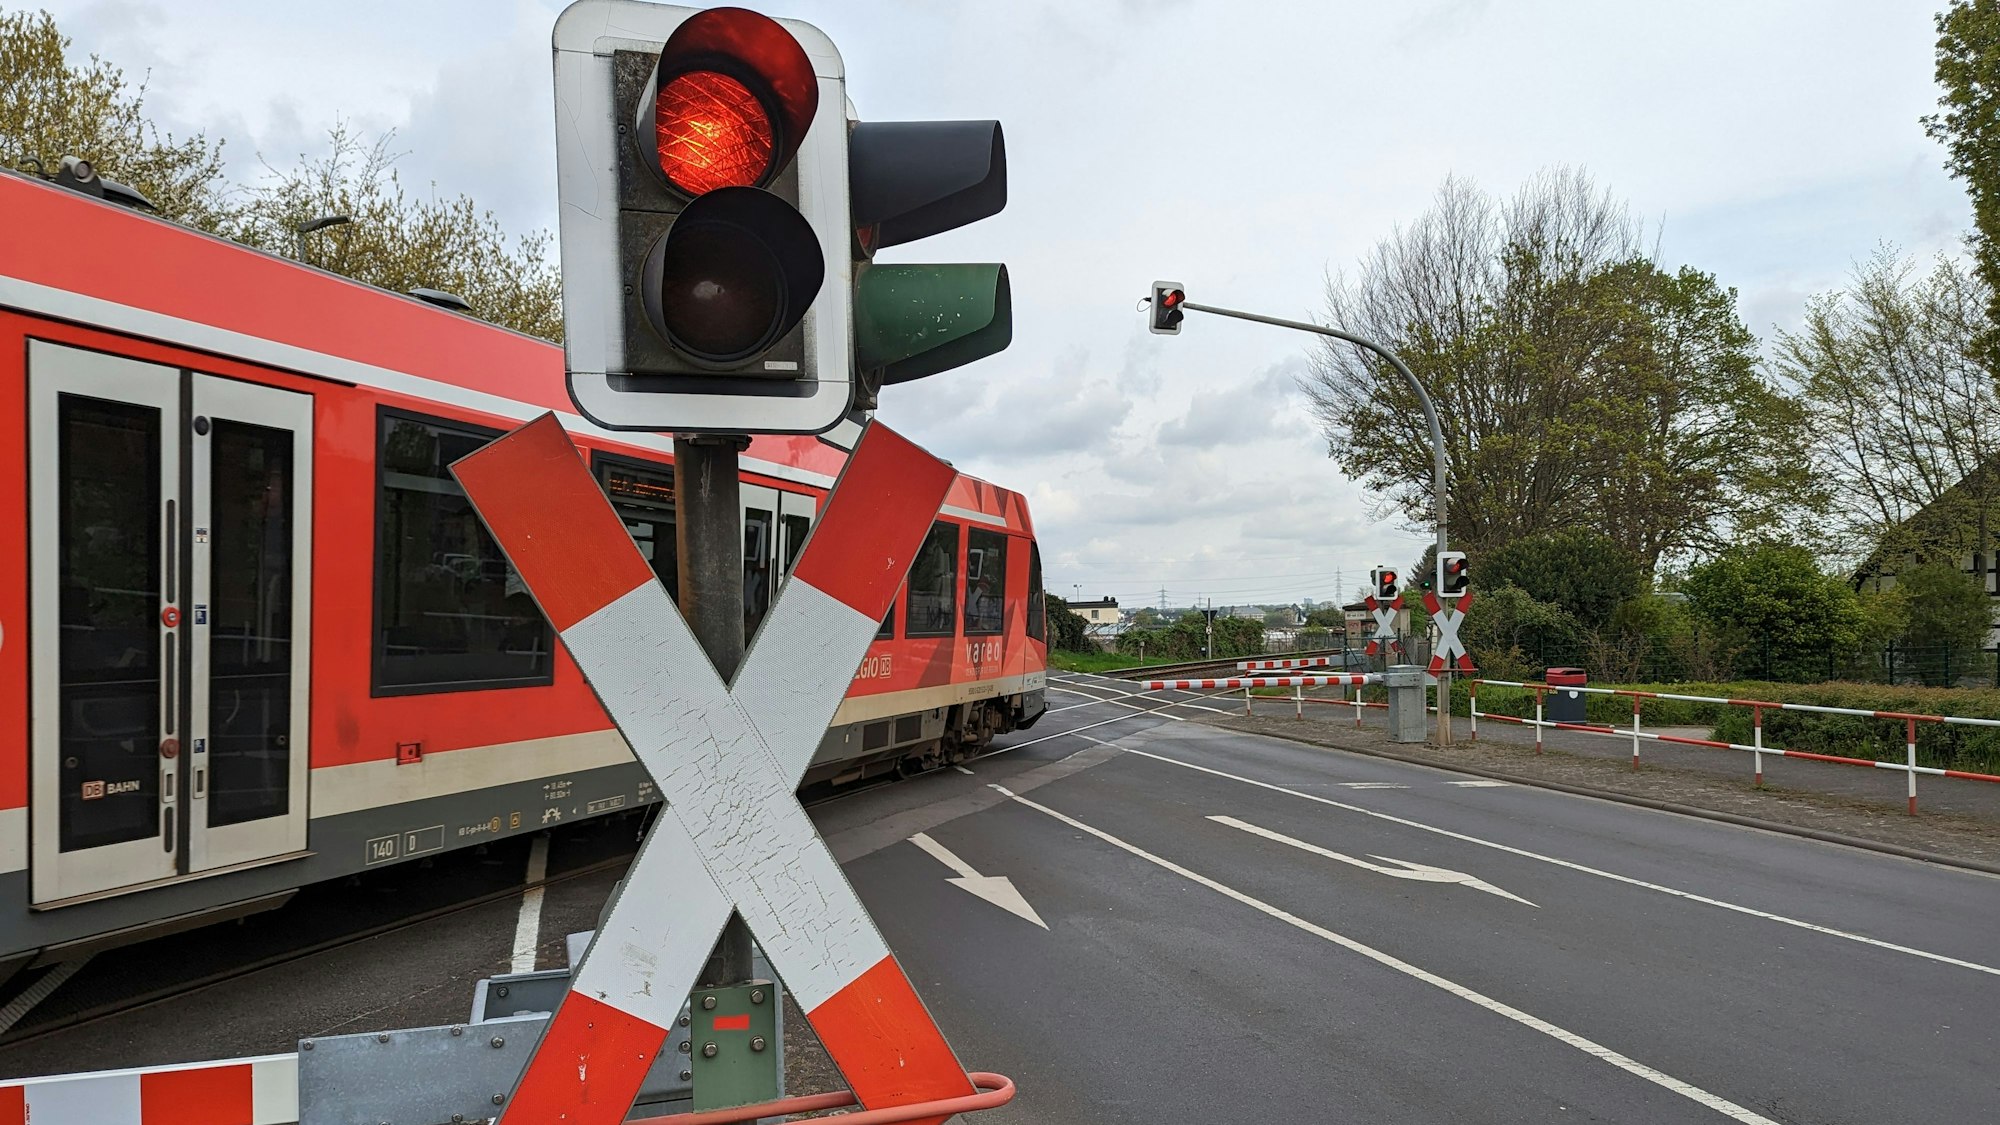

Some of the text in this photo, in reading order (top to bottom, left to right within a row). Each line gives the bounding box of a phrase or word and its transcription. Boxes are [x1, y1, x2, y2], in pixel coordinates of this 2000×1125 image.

[966, 641, 1000, 664] vareo
[84, 780, 140, 798] DB BAHN
[373, 840, 393, 859] 140
[408, 835, 416, 851] D
